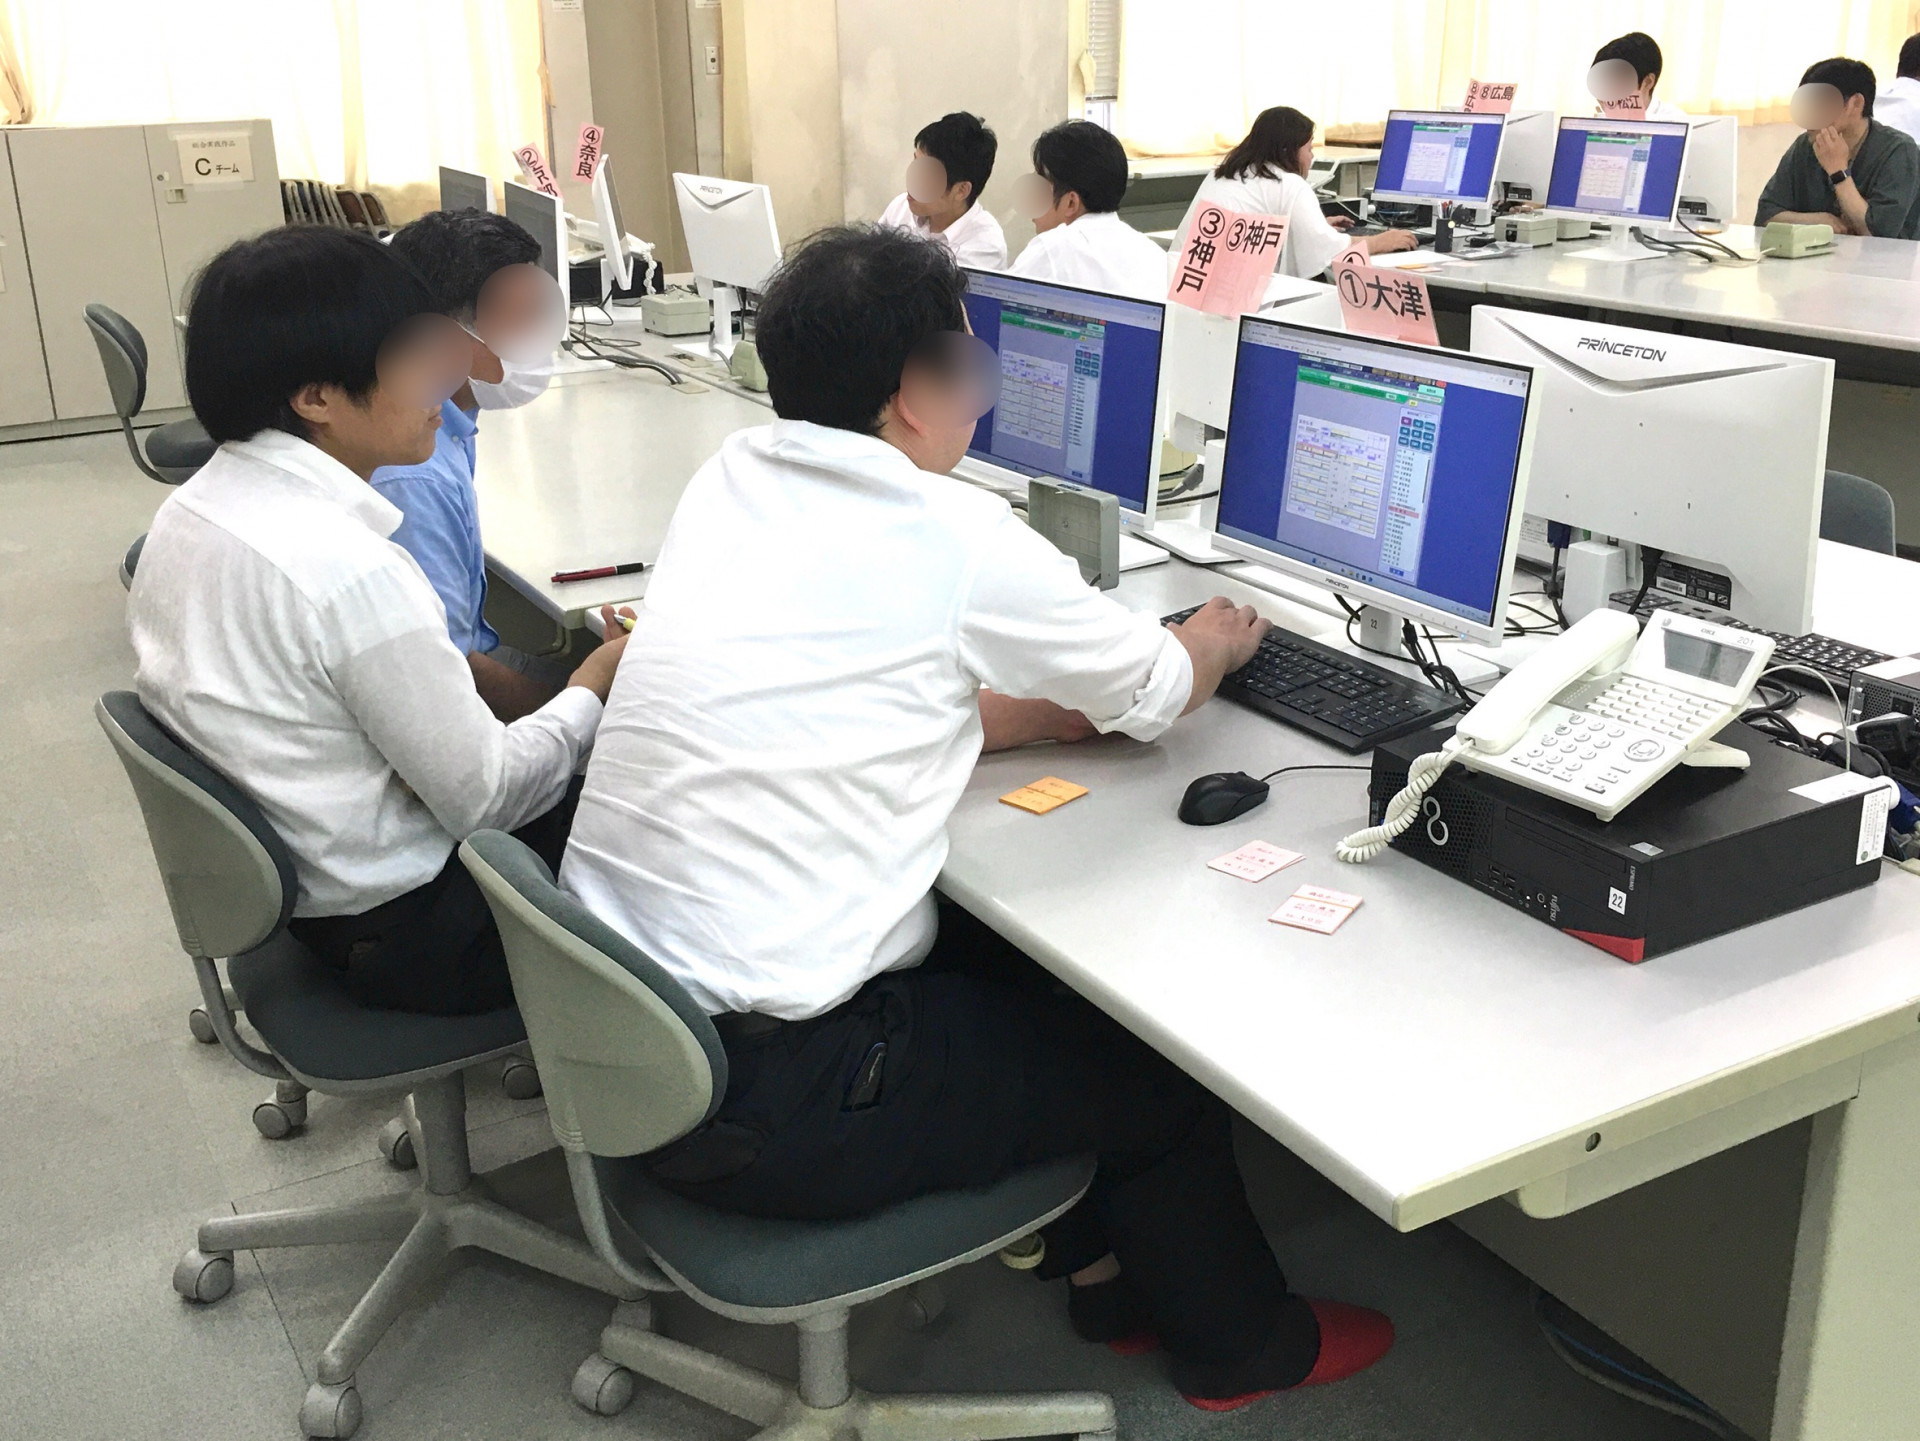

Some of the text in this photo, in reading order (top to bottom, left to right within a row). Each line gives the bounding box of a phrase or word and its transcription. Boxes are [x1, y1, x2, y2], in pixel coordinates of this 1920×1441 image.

[577, 127, 600, 179] ④奈良
[215, 163, 240, 175] チーム
[1226, 218, 1284, 256] ③神戸
[1176, 207, 1226, 294] ③神戸
[1339, 269, 1427, 321] ①大津
[1577, 337, 1667, 363] PRINCETON
[1370, 618, 1378, 630] 22
[1736, 636, 1755, 647] 201
[1611, 893, 1623, 909] 22
